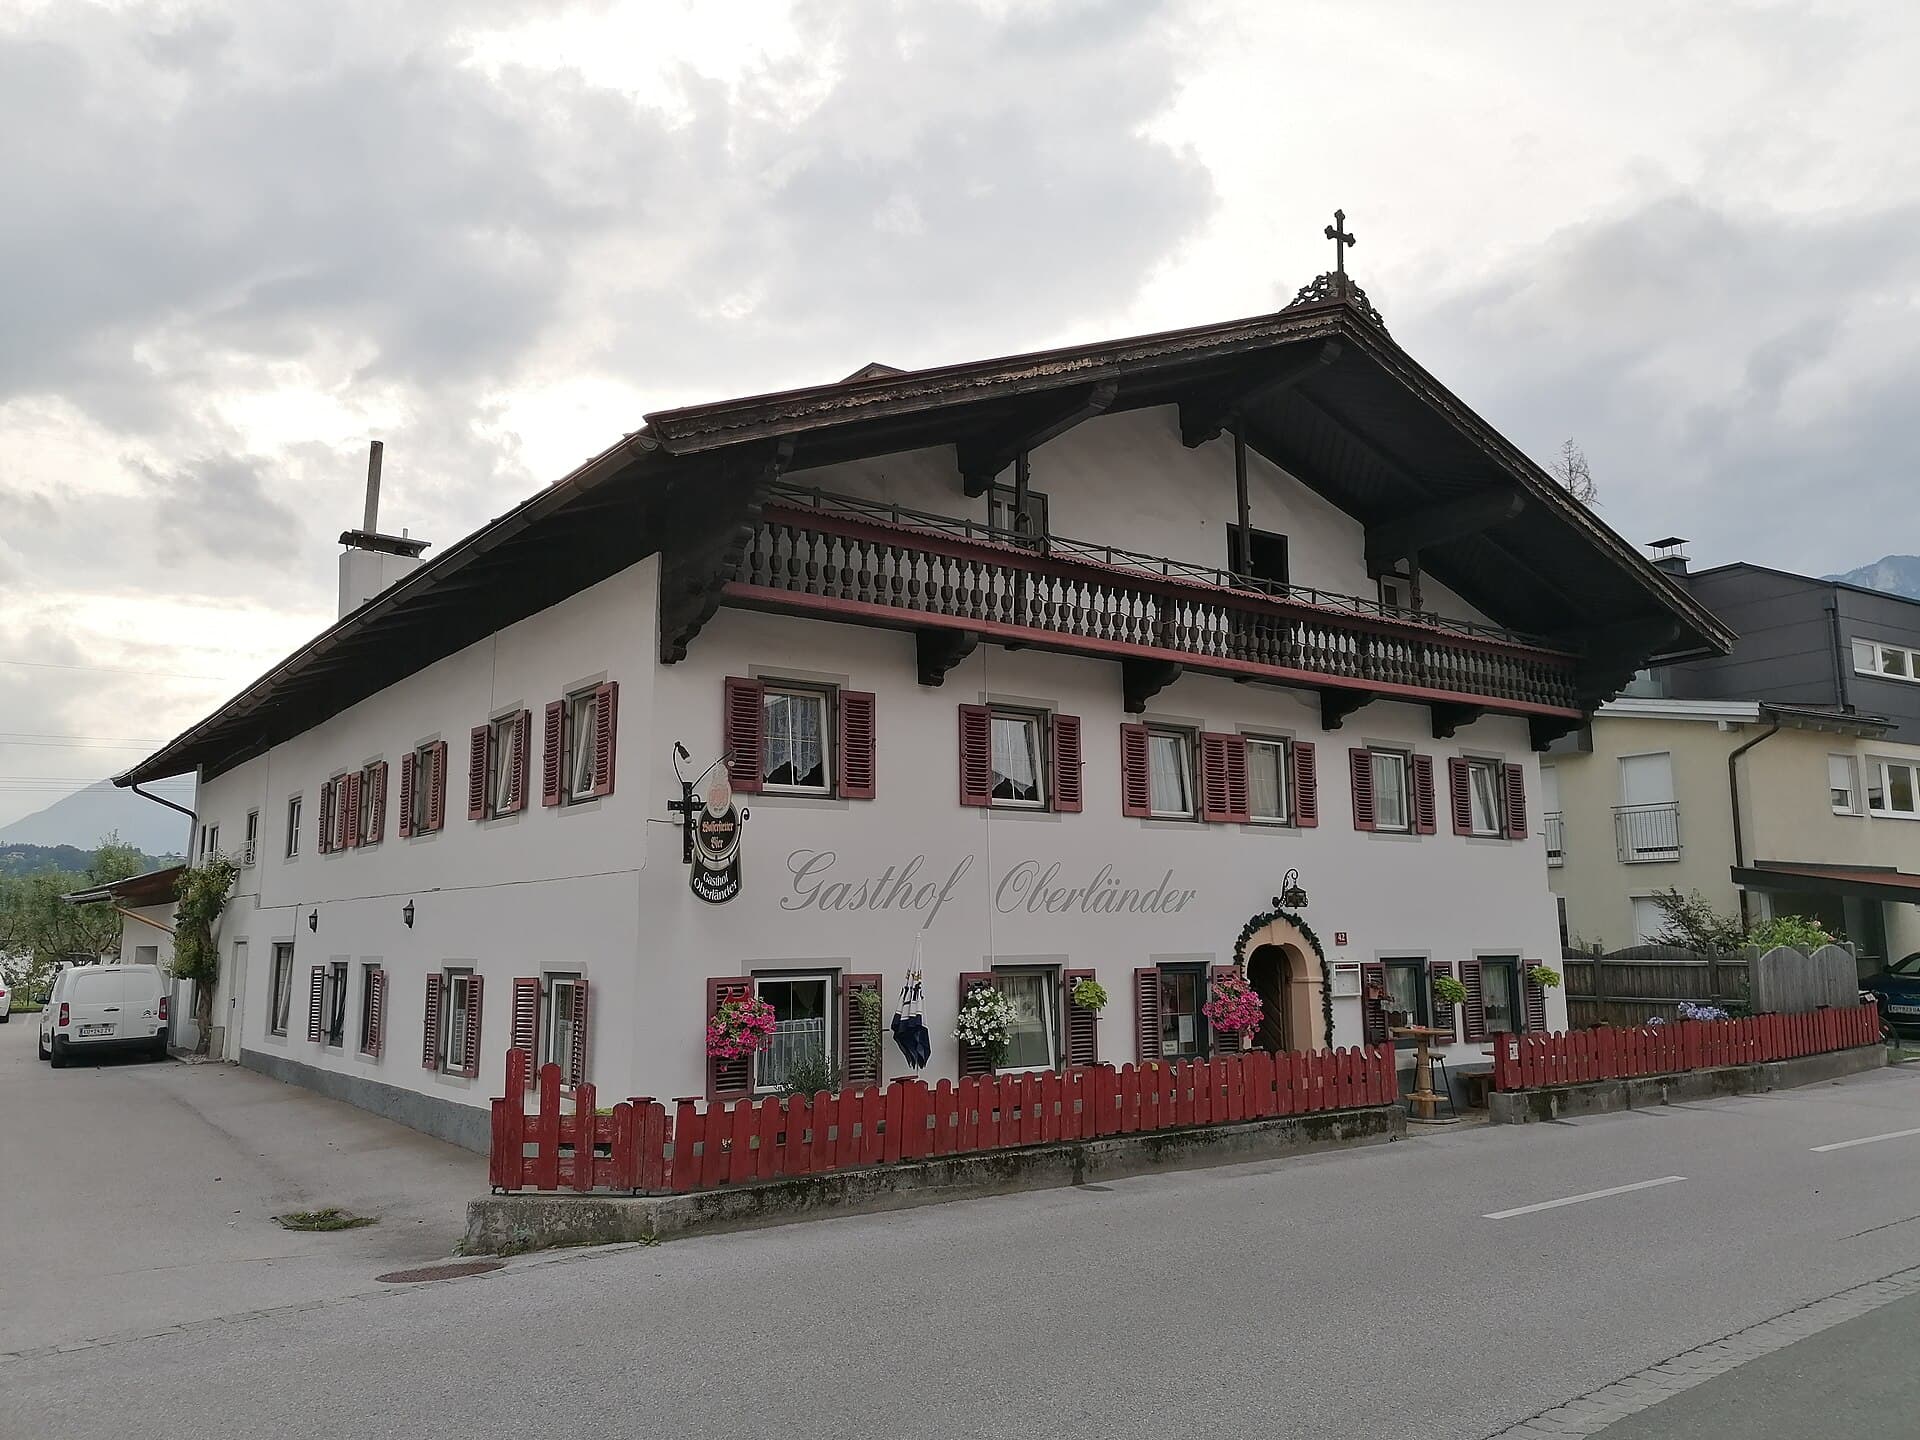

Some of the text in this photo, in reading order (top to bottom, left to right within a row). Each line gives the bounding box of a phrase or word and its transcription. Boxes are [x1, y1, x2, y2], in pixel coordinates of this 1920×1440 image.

[703, 870, 729, 887] Gasthof
[694, 877, 737, 901] Oberländer
[779, 848, 1198, 930] Gasthof Oberländer
[1337, 933, 1346, 941] 42
